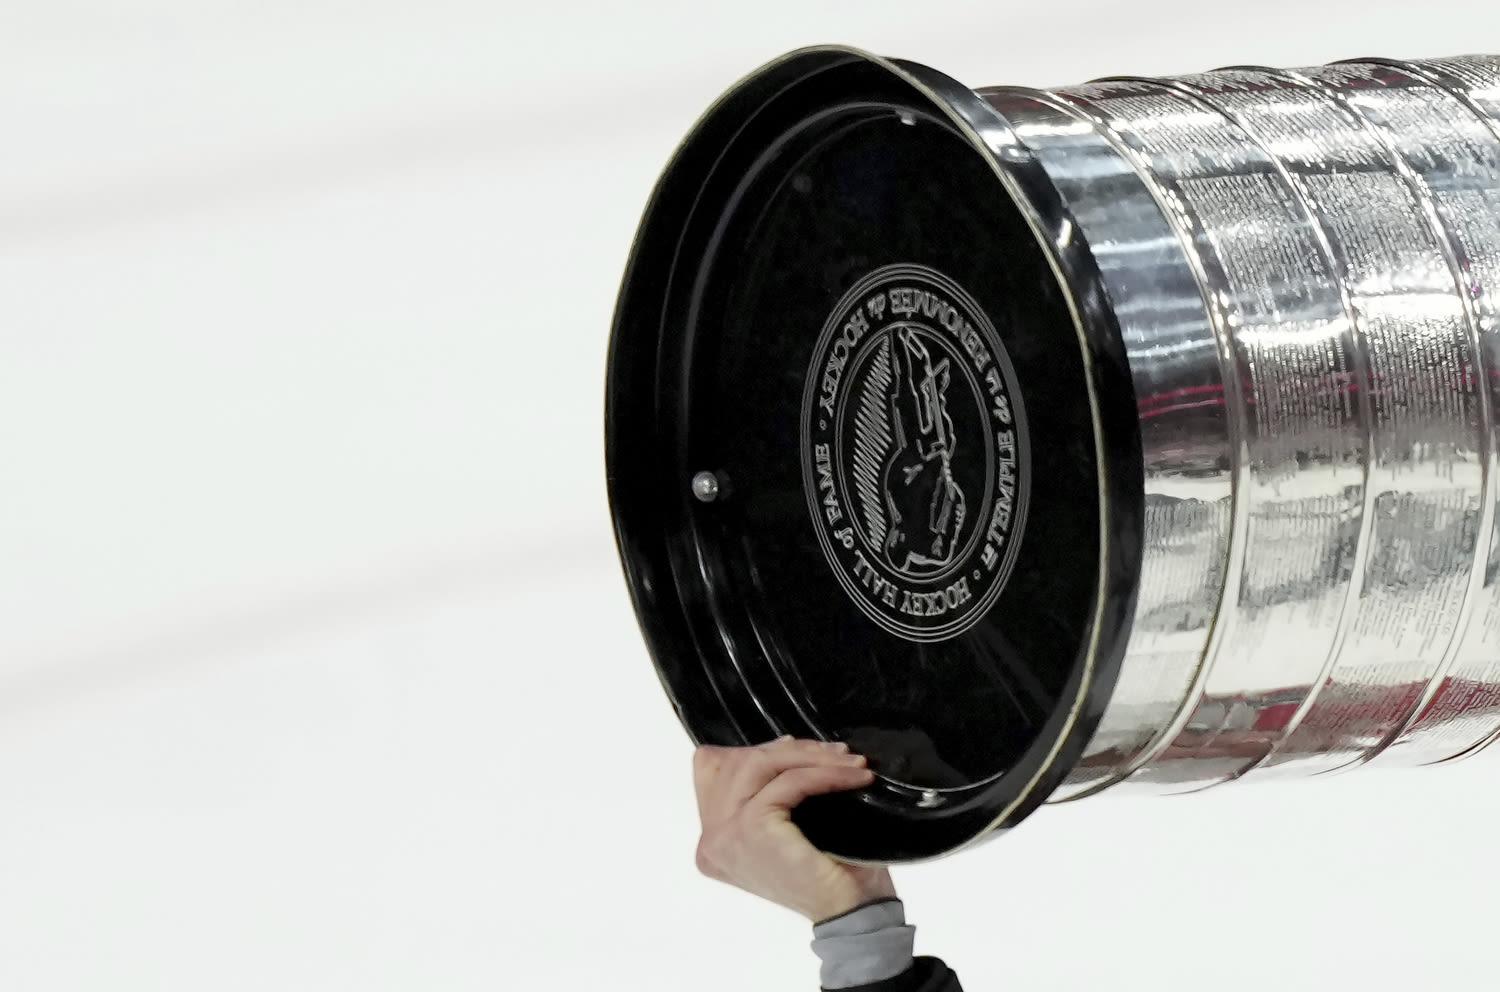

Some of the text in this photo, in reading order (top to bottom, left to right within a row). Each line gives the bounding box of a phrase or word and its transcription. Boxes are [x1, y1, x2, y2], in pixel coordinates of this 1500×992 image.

[819, 306, 871, 418] HOCKEY
[889, 287, 991, 374] RENOMMÉE
[814, 443, 973, 617] HOCKEY HALL of FAME
[987, 428, 1016, 548] TEMPLE
